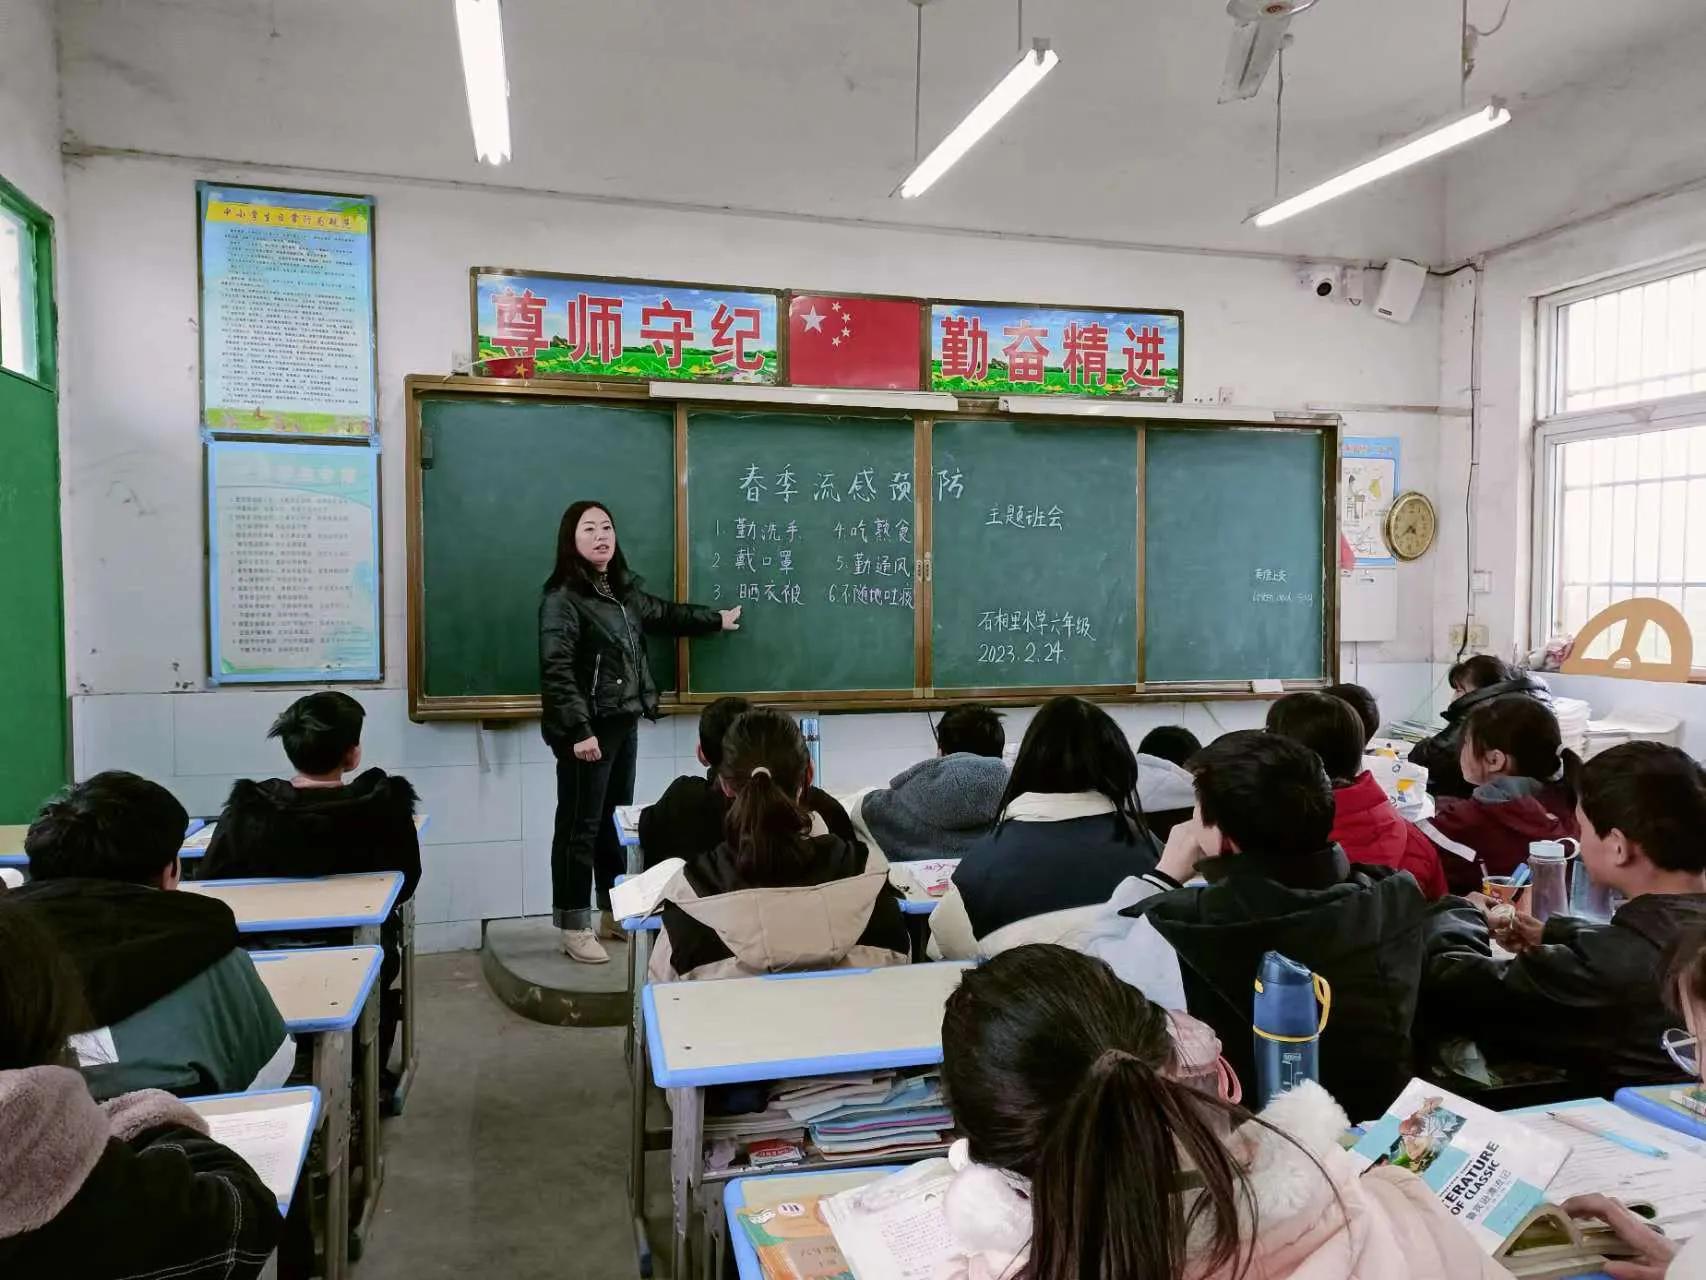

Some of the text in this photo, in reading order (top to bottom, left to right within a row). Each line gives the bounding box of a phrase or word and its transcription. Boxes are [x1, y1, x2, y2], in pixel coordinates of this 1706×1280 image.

[489, 290, 765, 371] 尊师守纪
[939, 316, 1167, 388] 勤奋精进
[739, 462, 966, 503] 春季流感预防
[984, 503, 1066, 531] 主题班会
[976, 608, 1097, 641] 石相里小学六年级
[1450, 1201, 1465, 1216] OF
[1464, 1160, 1500, 1200] CLASSIC
